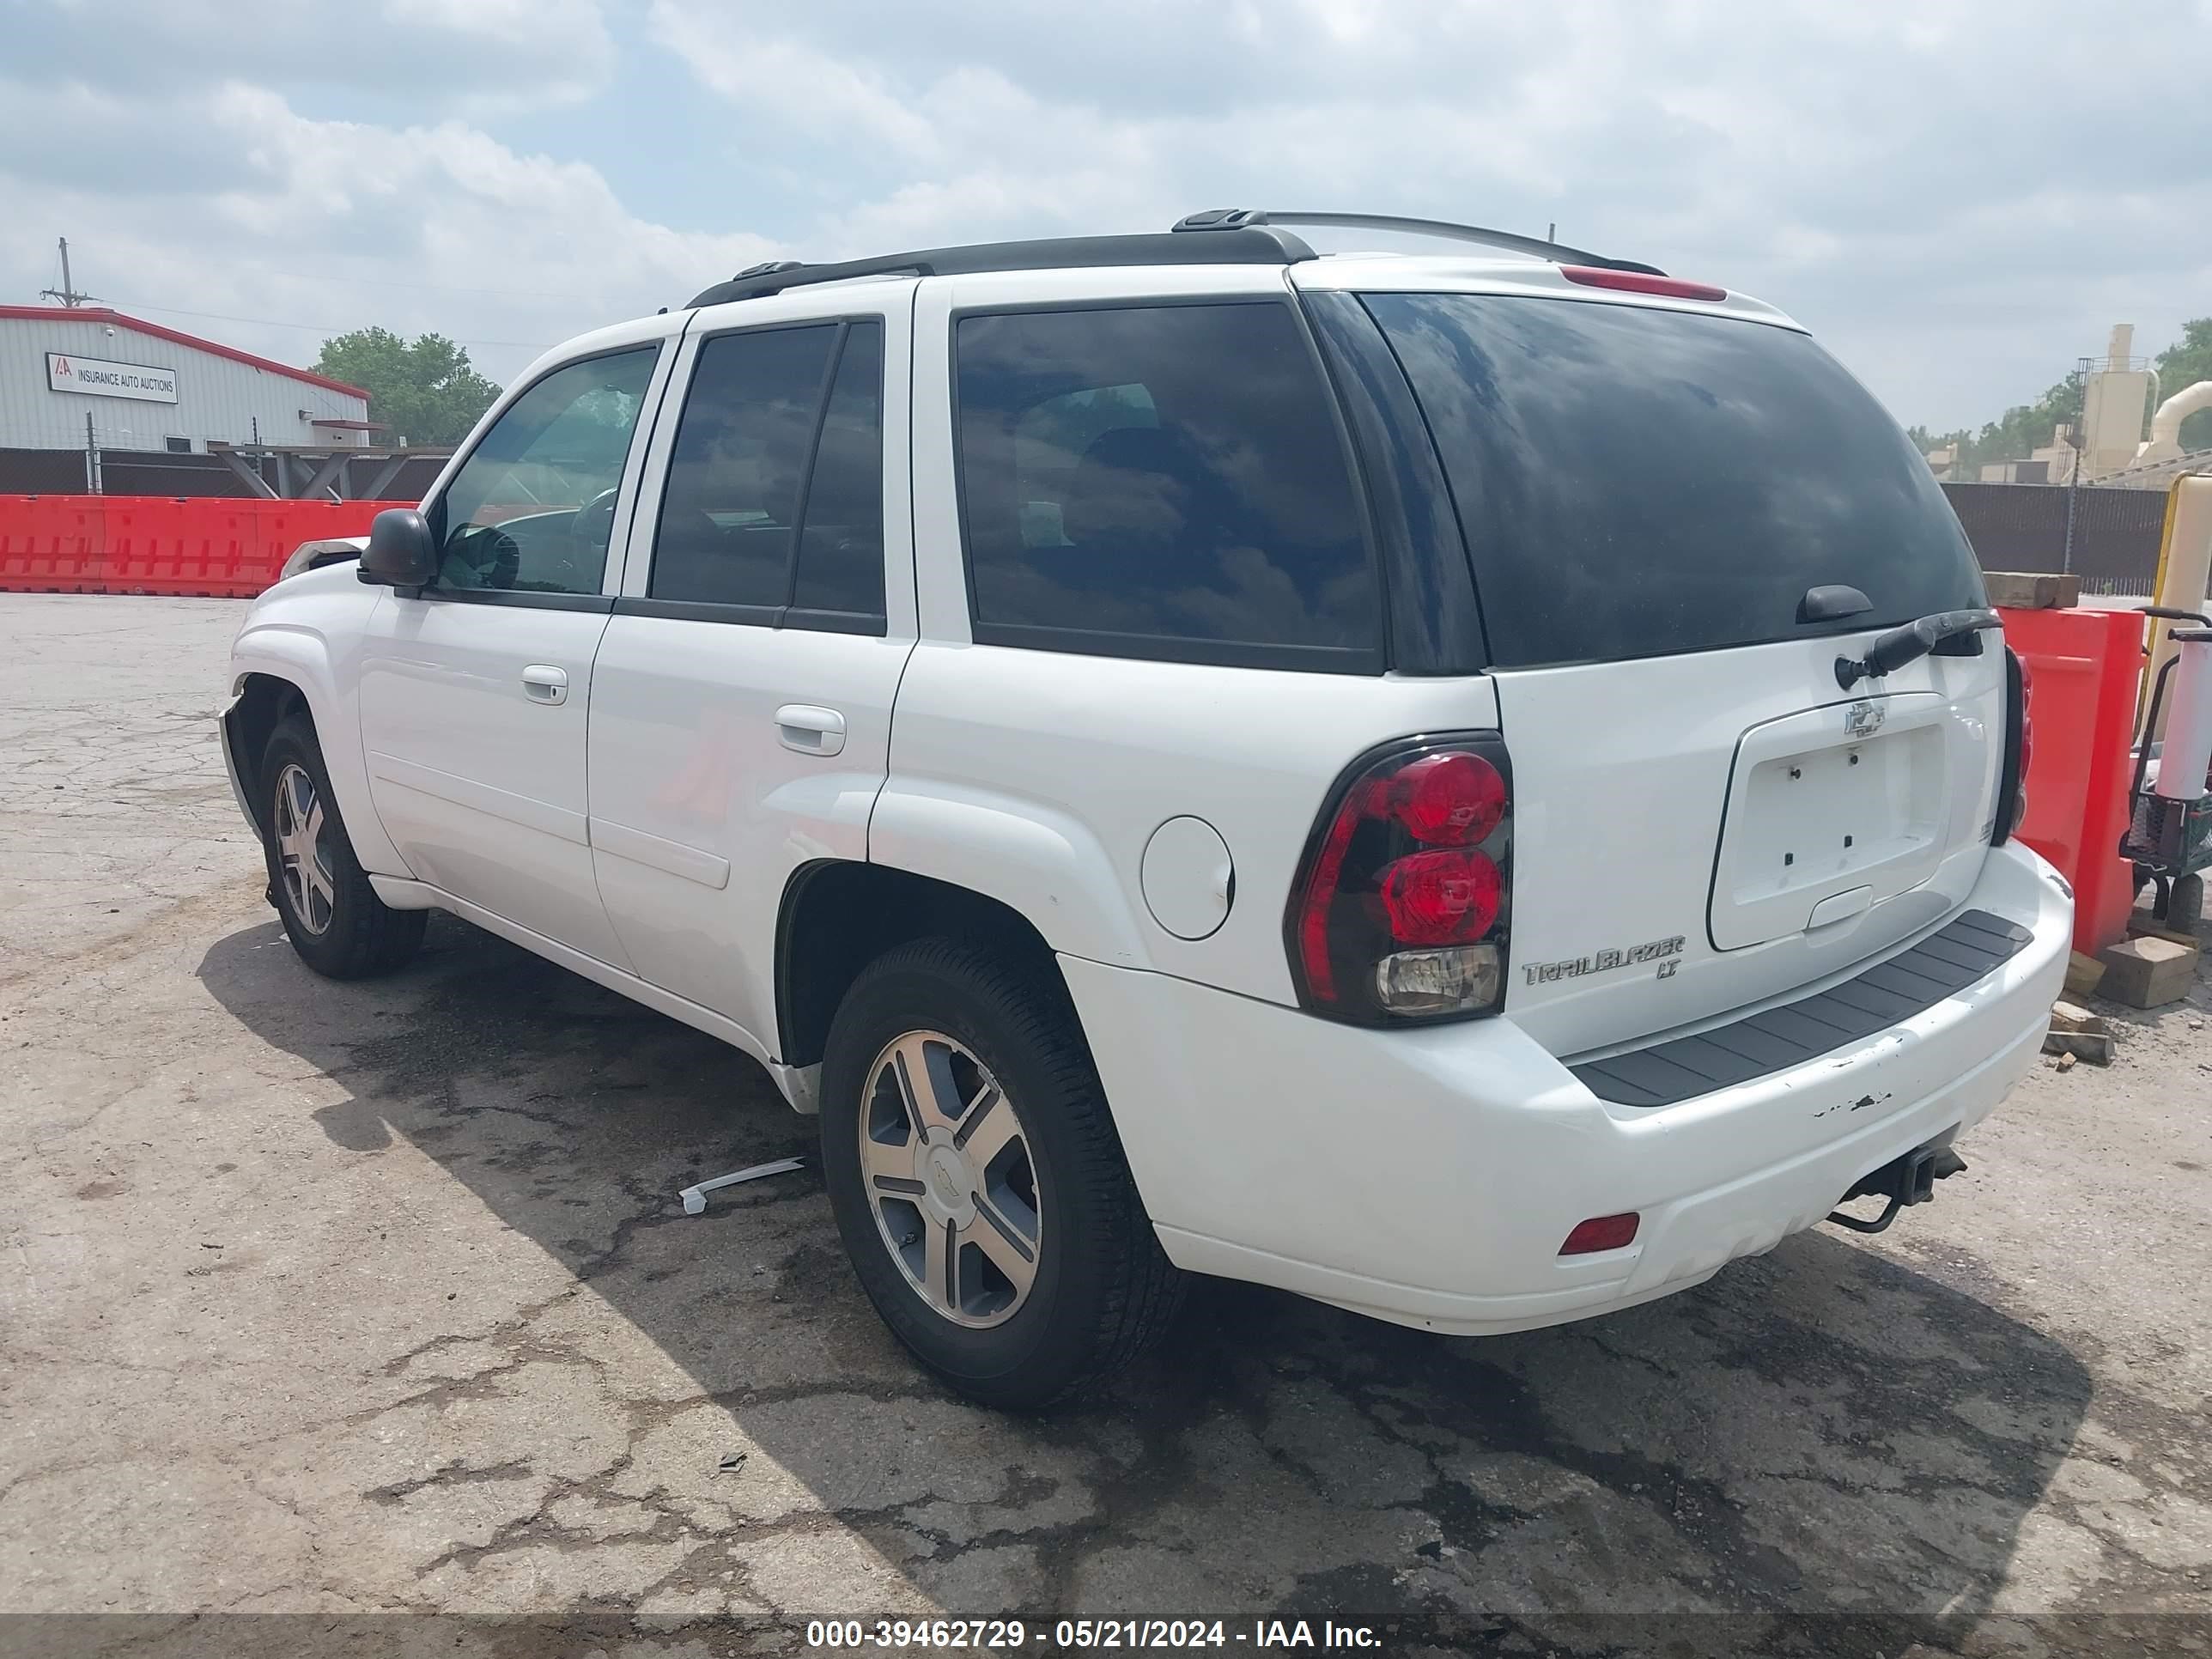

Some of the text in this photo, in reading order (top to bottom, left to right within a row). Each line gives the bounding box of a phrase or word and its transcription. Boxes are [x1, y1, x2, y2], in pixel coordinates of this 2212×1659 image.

[78, 369, 173, 392] INSURANCE AUTO AUCTIONS
[1522, 934, 1686, 986] TRAILBLAZER
[1656, 957, 1682, 980] LT
